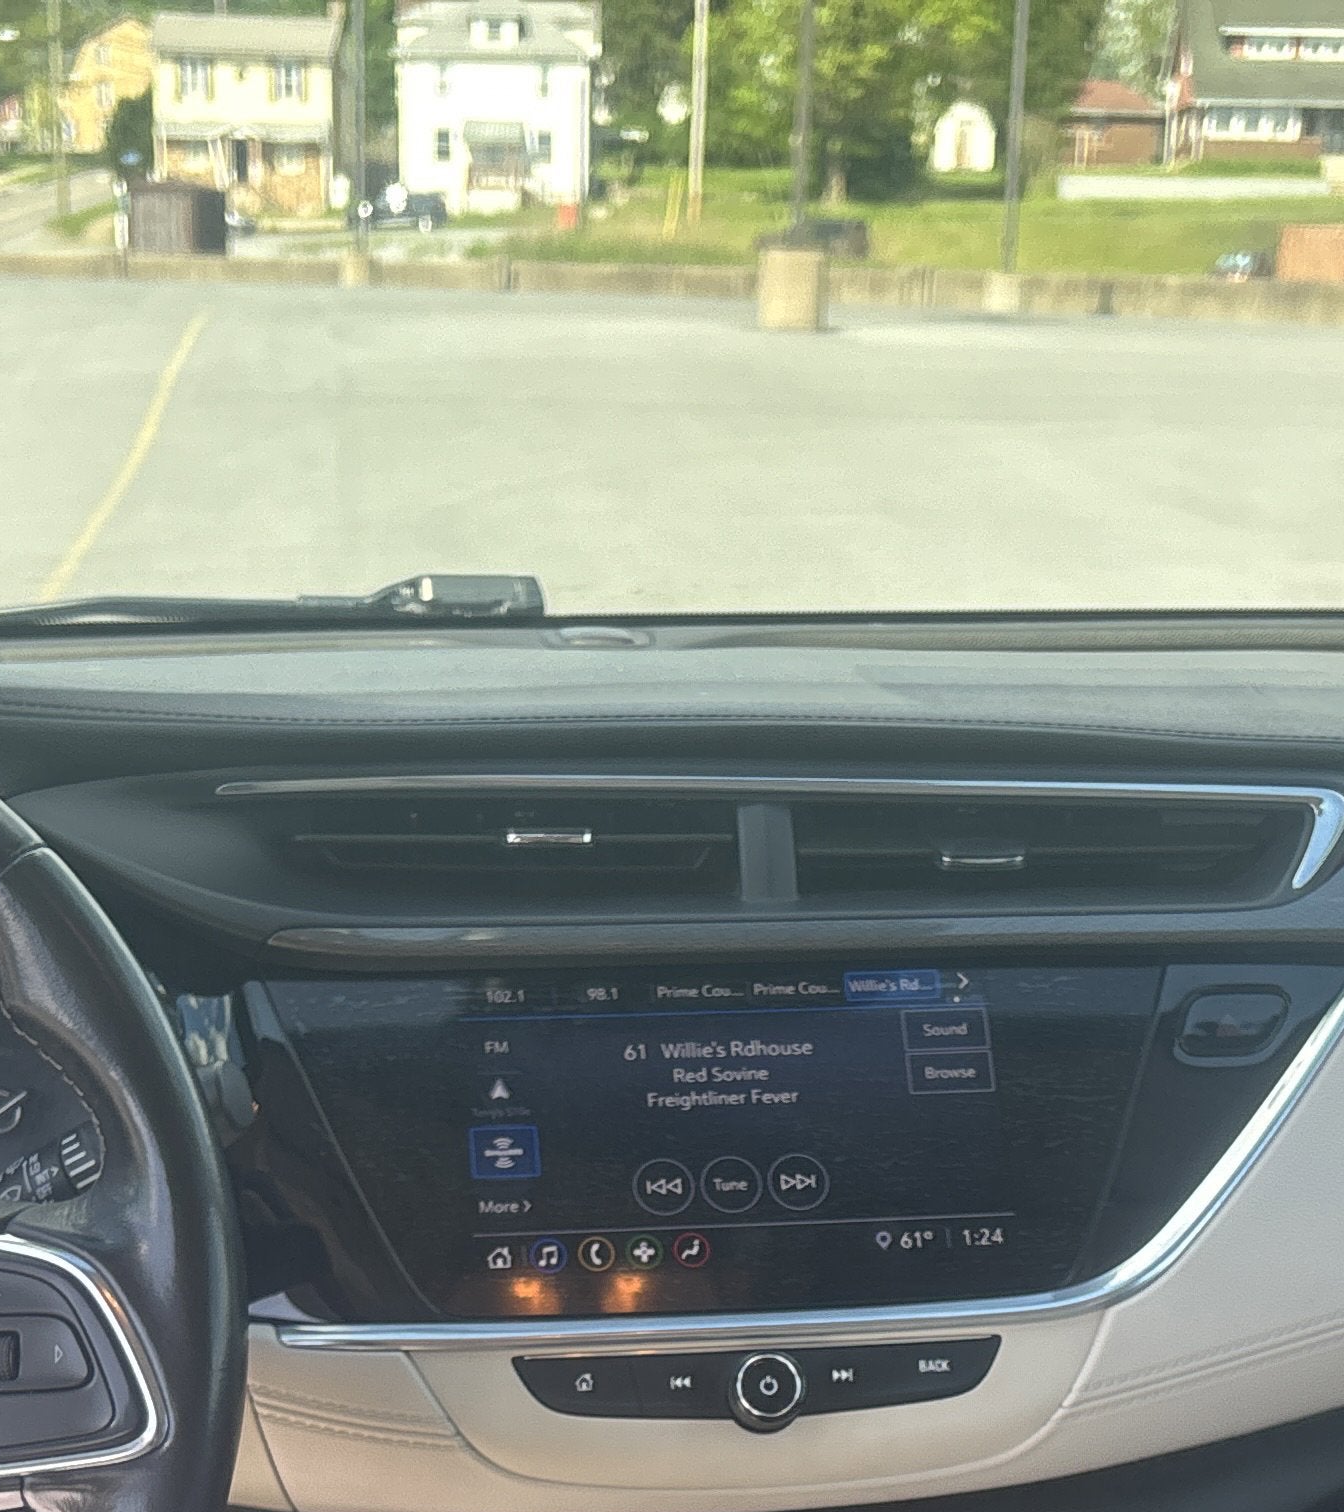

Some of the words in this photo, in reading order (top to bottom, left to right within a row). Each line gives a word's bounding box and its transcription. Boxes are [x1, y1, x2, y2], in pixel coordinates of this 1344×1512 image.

[586, 986, 619, 1001] 98.1
[657, 984, 699, 998] Prime
[753, 982, 795, 996] Prime
[848, 979, 897, 993] Willie's
[485, 988, 526, 1004] 102.1
[922, 1022, 969, 1037] Sound
[483, 1040, 510, 1054] FM
[623, 1044, 647, 1061] 61
[660, 1041, 726, 1060] Willie's
[730, 1038, 813, 1057] Rdhouse
[672, 1068, 707, 1083] Red
[711, 1066, 770, 1081] Sovine
[923, 1065, 977, 1080] Browse
[647, 1091, 746, 1111] Freightliner
[750, 1088, 799, 1104] Fever
[713, 1177, 748, 1192] Tune
[478, 1201, 520, 1214] More
[900, 1230, 935, 1249] 61°
[962, 1228, 1004, 1246] 1:24
[918, 1358, 951, 1373] BACK
